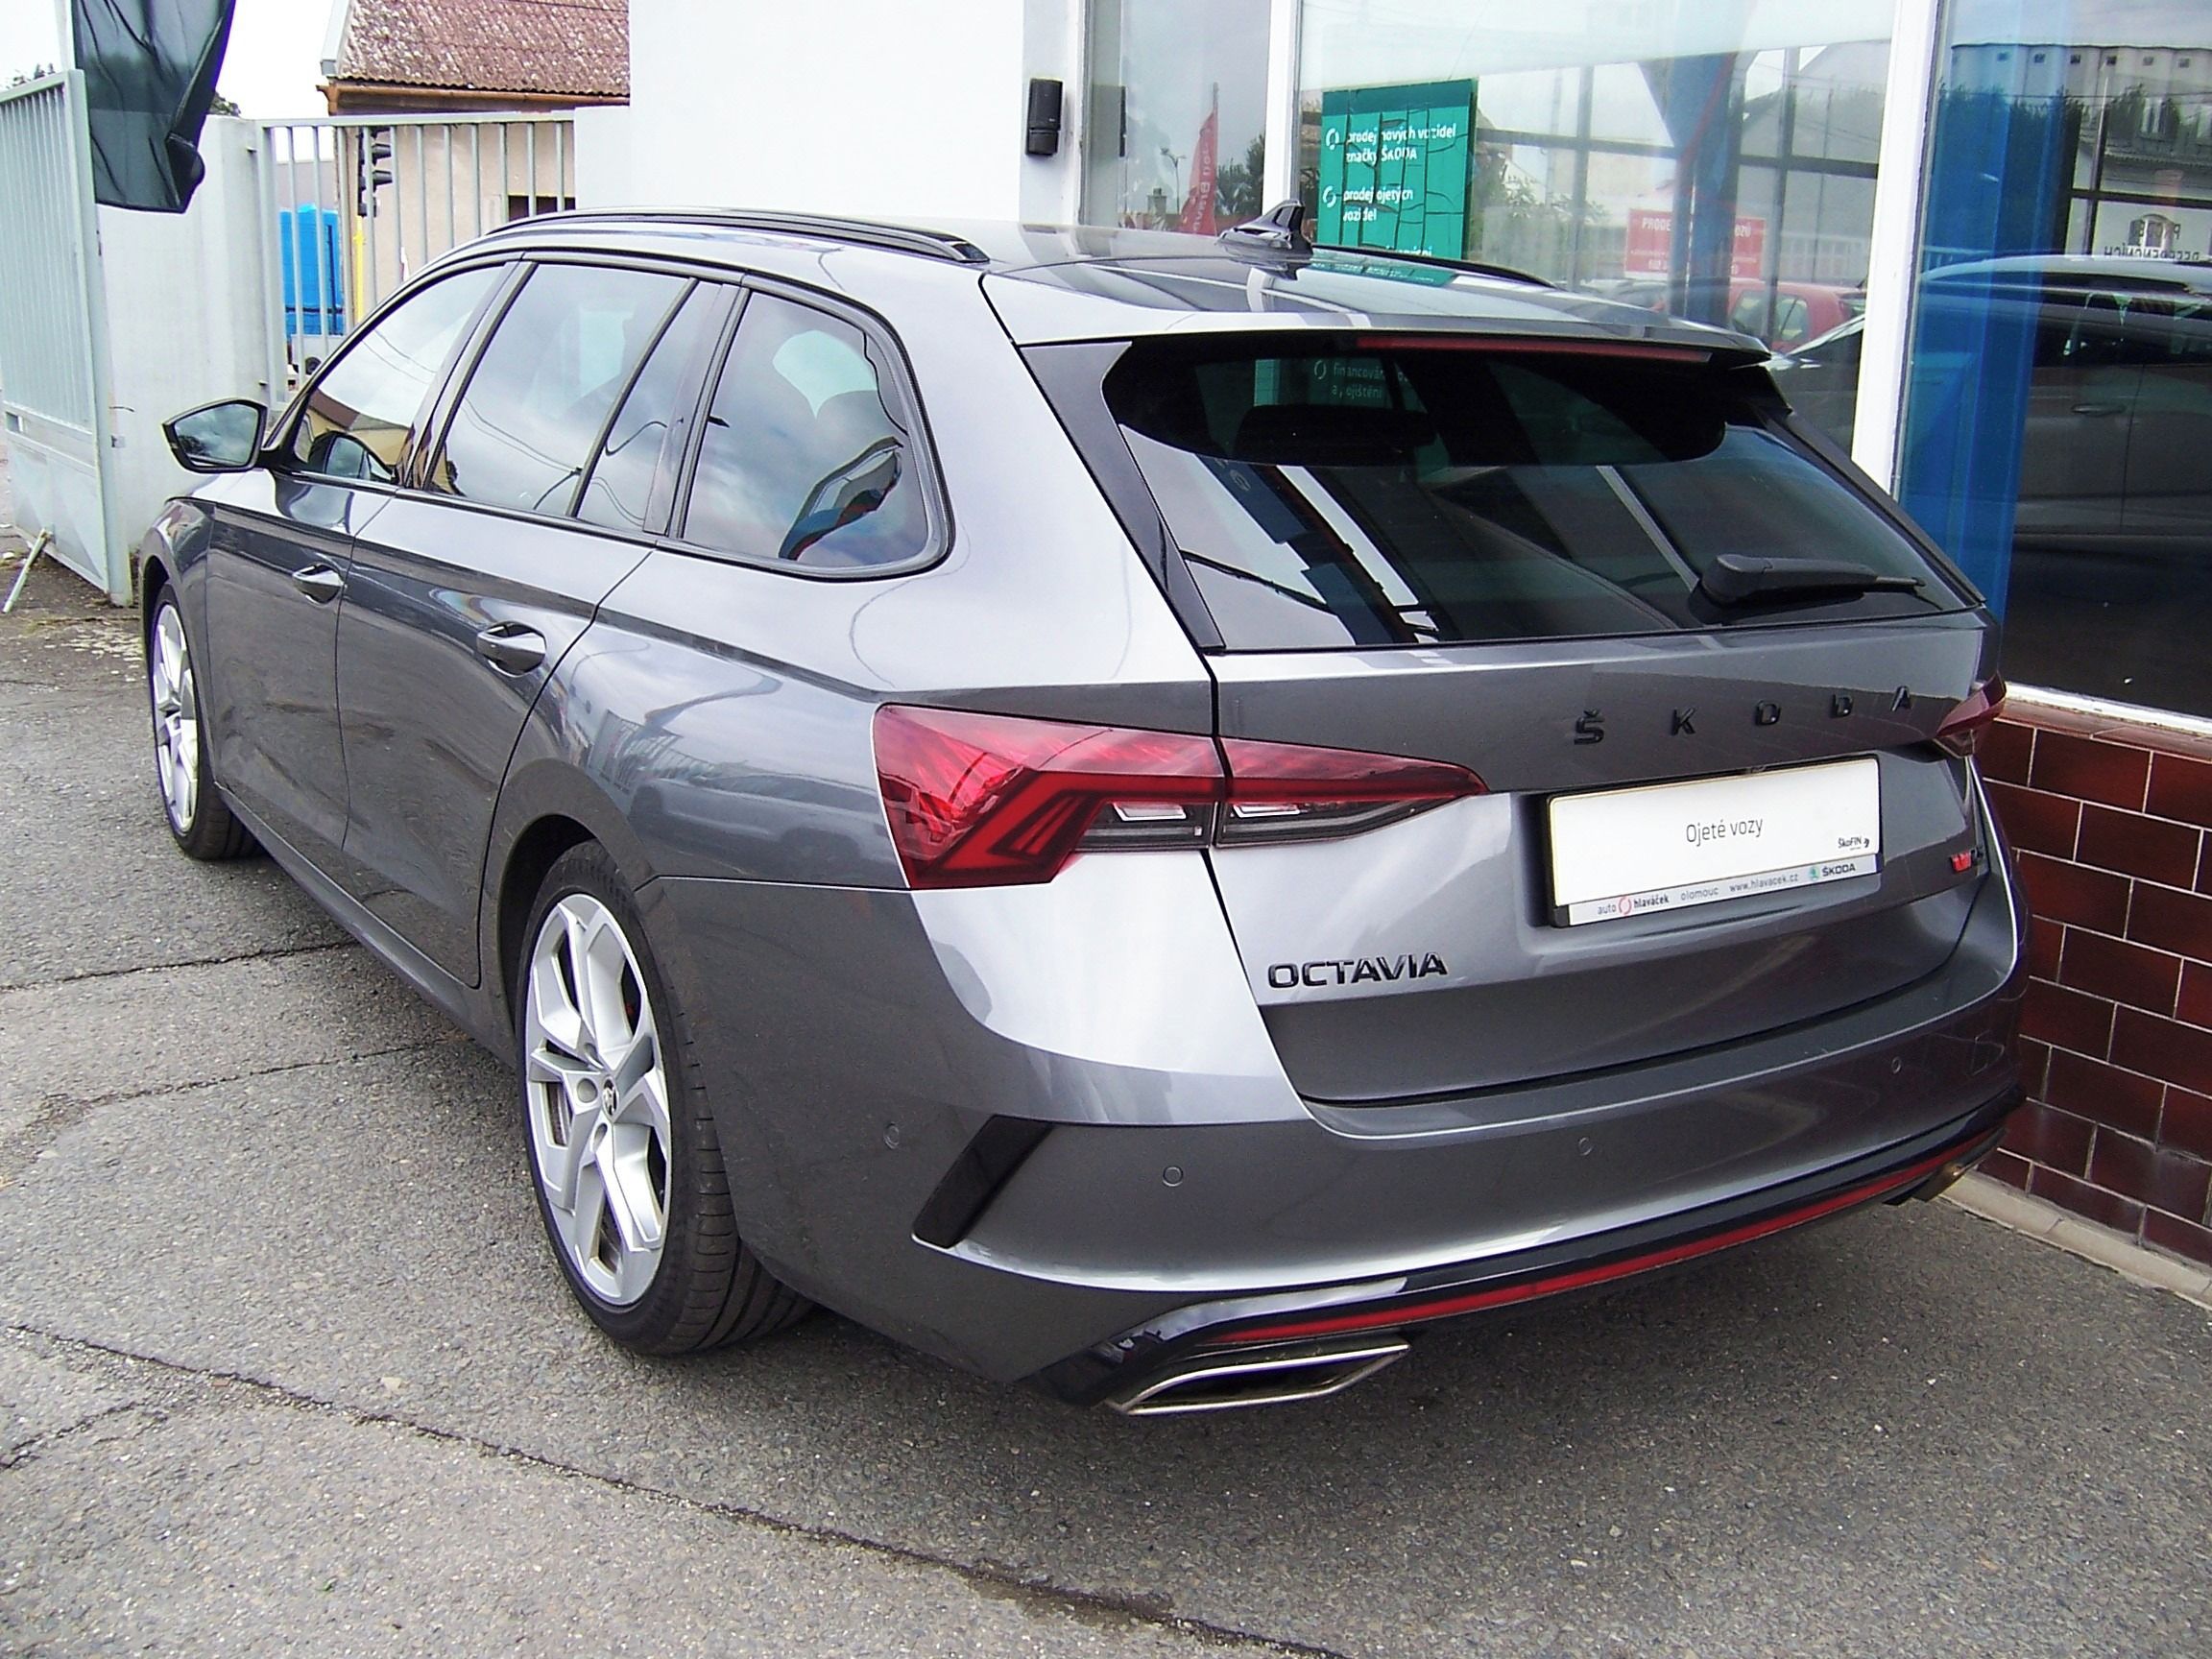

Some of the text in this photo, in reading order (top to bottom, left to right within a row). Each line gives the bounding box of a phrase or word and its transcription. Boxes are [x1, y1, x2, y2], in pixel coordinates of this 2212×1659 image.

[1343, 186, 1374, 204] prodej
[1573, 685, 1913, 746] ŠKODA
[1686, 818, 1764, 847] Ojeté vozy
[1597, 903, 1617, 915] auto
[1633, 893, 1670, 909] hlaváček
[1680, 885, 1719, 901] olomouc
[1821, 862, 1856, 878] ŠKODA
[1267, 951, 1449, 989] OCTAVIA
